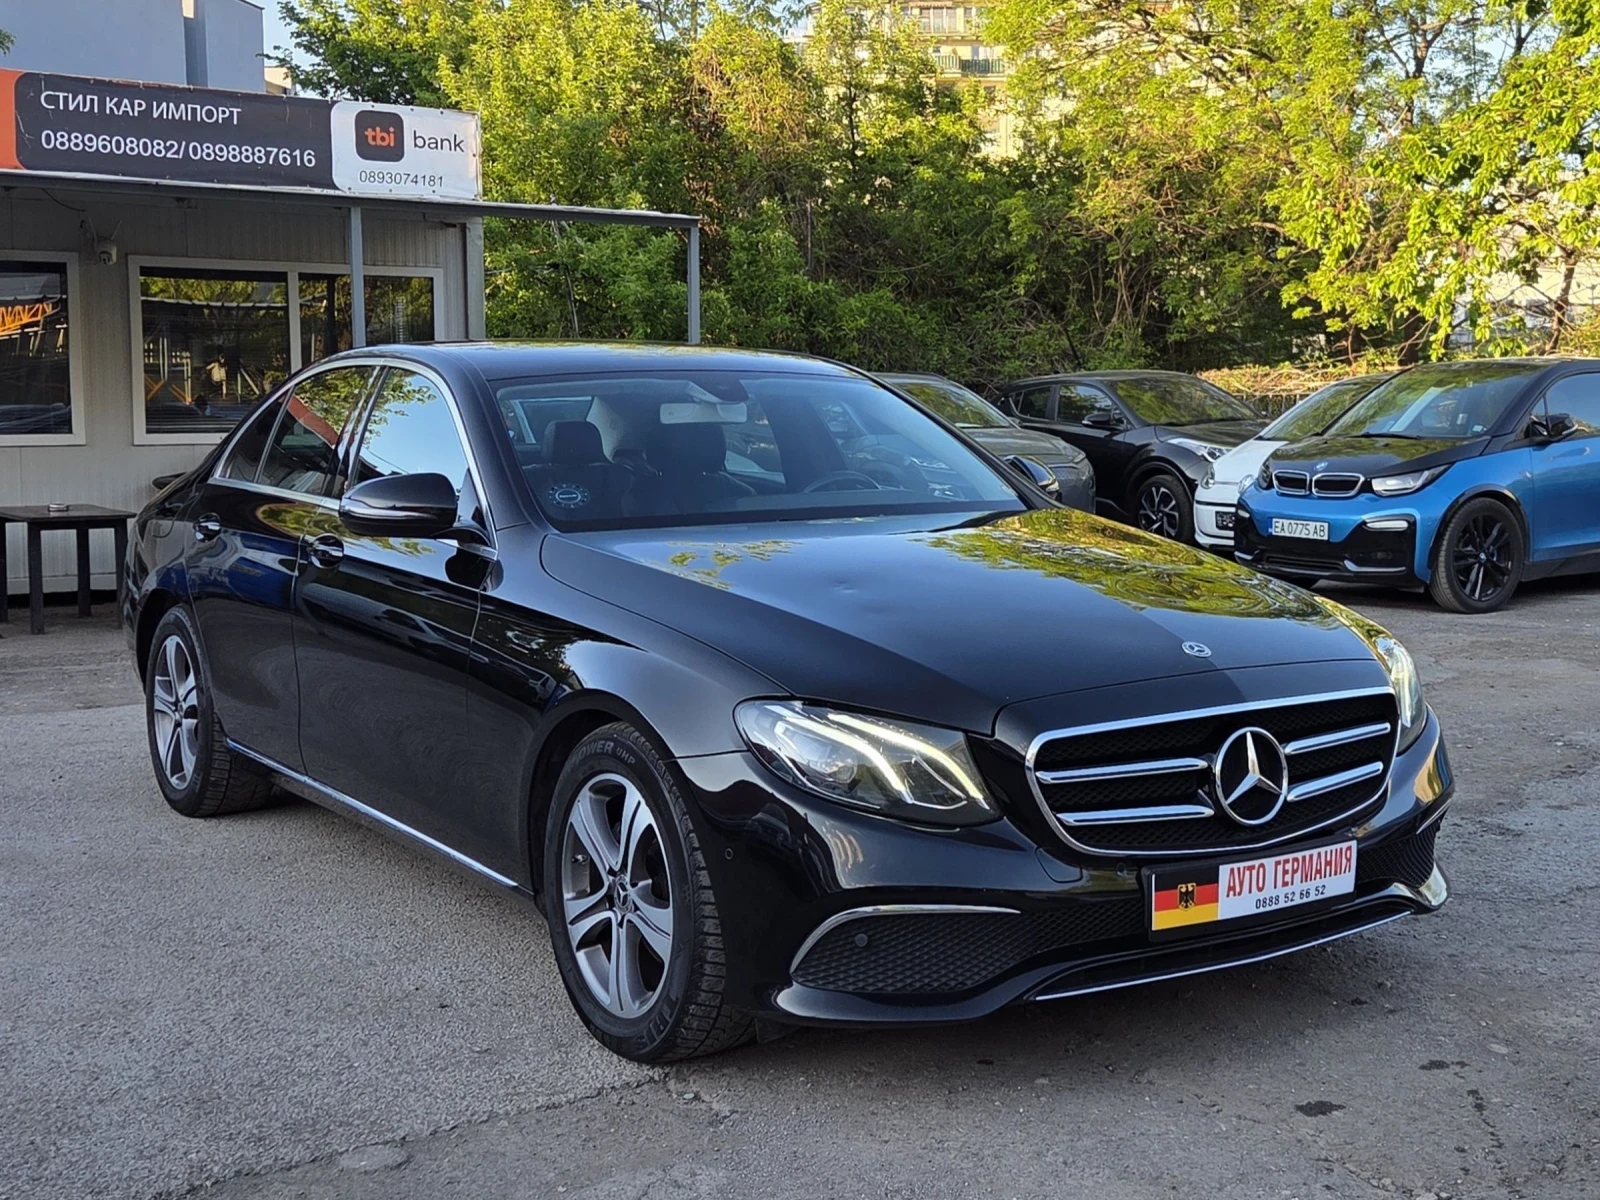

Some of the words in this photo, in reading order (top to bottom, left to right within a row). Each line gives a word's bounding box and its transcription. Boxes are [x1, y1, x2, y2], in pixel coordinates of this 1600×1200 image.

[41, 91, 98, 114] СТИЛ
[105, 96, 147, 117] КАР
[153, 101, 242, 125] ИМПОРТ
[364, 127, 394, 147] tbi
[413, 130, 464, 153] bank
[359, 169, 443, 188] 0893074181
[1274, 521, 1286, 534] EA
[1287, 522, 1311, 536] 0775
[1312, 524, 1326, 538] AB
[1226, 862, 1266, 897] АУТО
[1274, 845, 1352, 889] ГЕРМАНИЯ
[1255, 894, 1280, 910] 0888
[1284, 891, 1296, 904] 52
[1299, 888, 1311, 900] 66
[1314, 884, 1326, 897] 52
